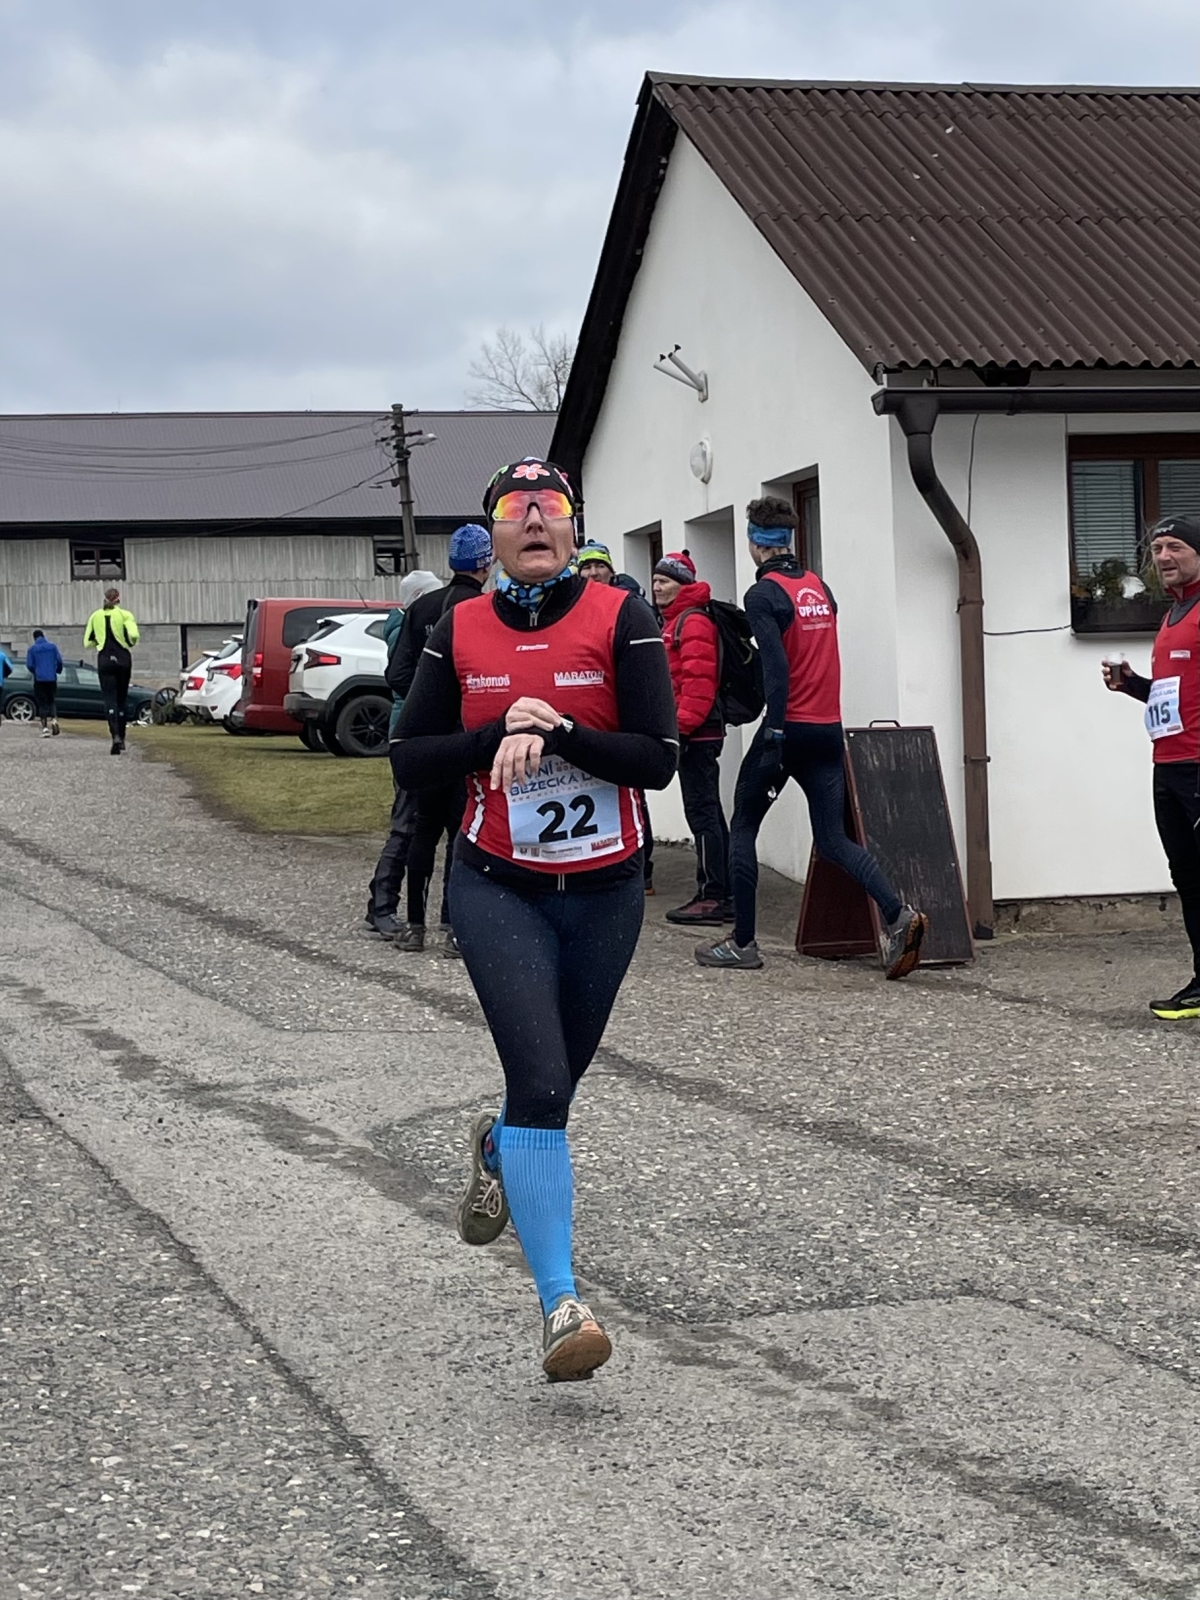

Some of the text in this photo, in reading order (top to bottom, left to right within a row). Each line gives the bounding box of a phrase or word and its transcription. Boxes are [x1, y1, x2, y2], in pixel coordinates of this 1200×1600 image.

[554, 670, 605, 681] MARATON
[1149, 701, 1171, 727] 115
[536, 795, 598, 843] 22
